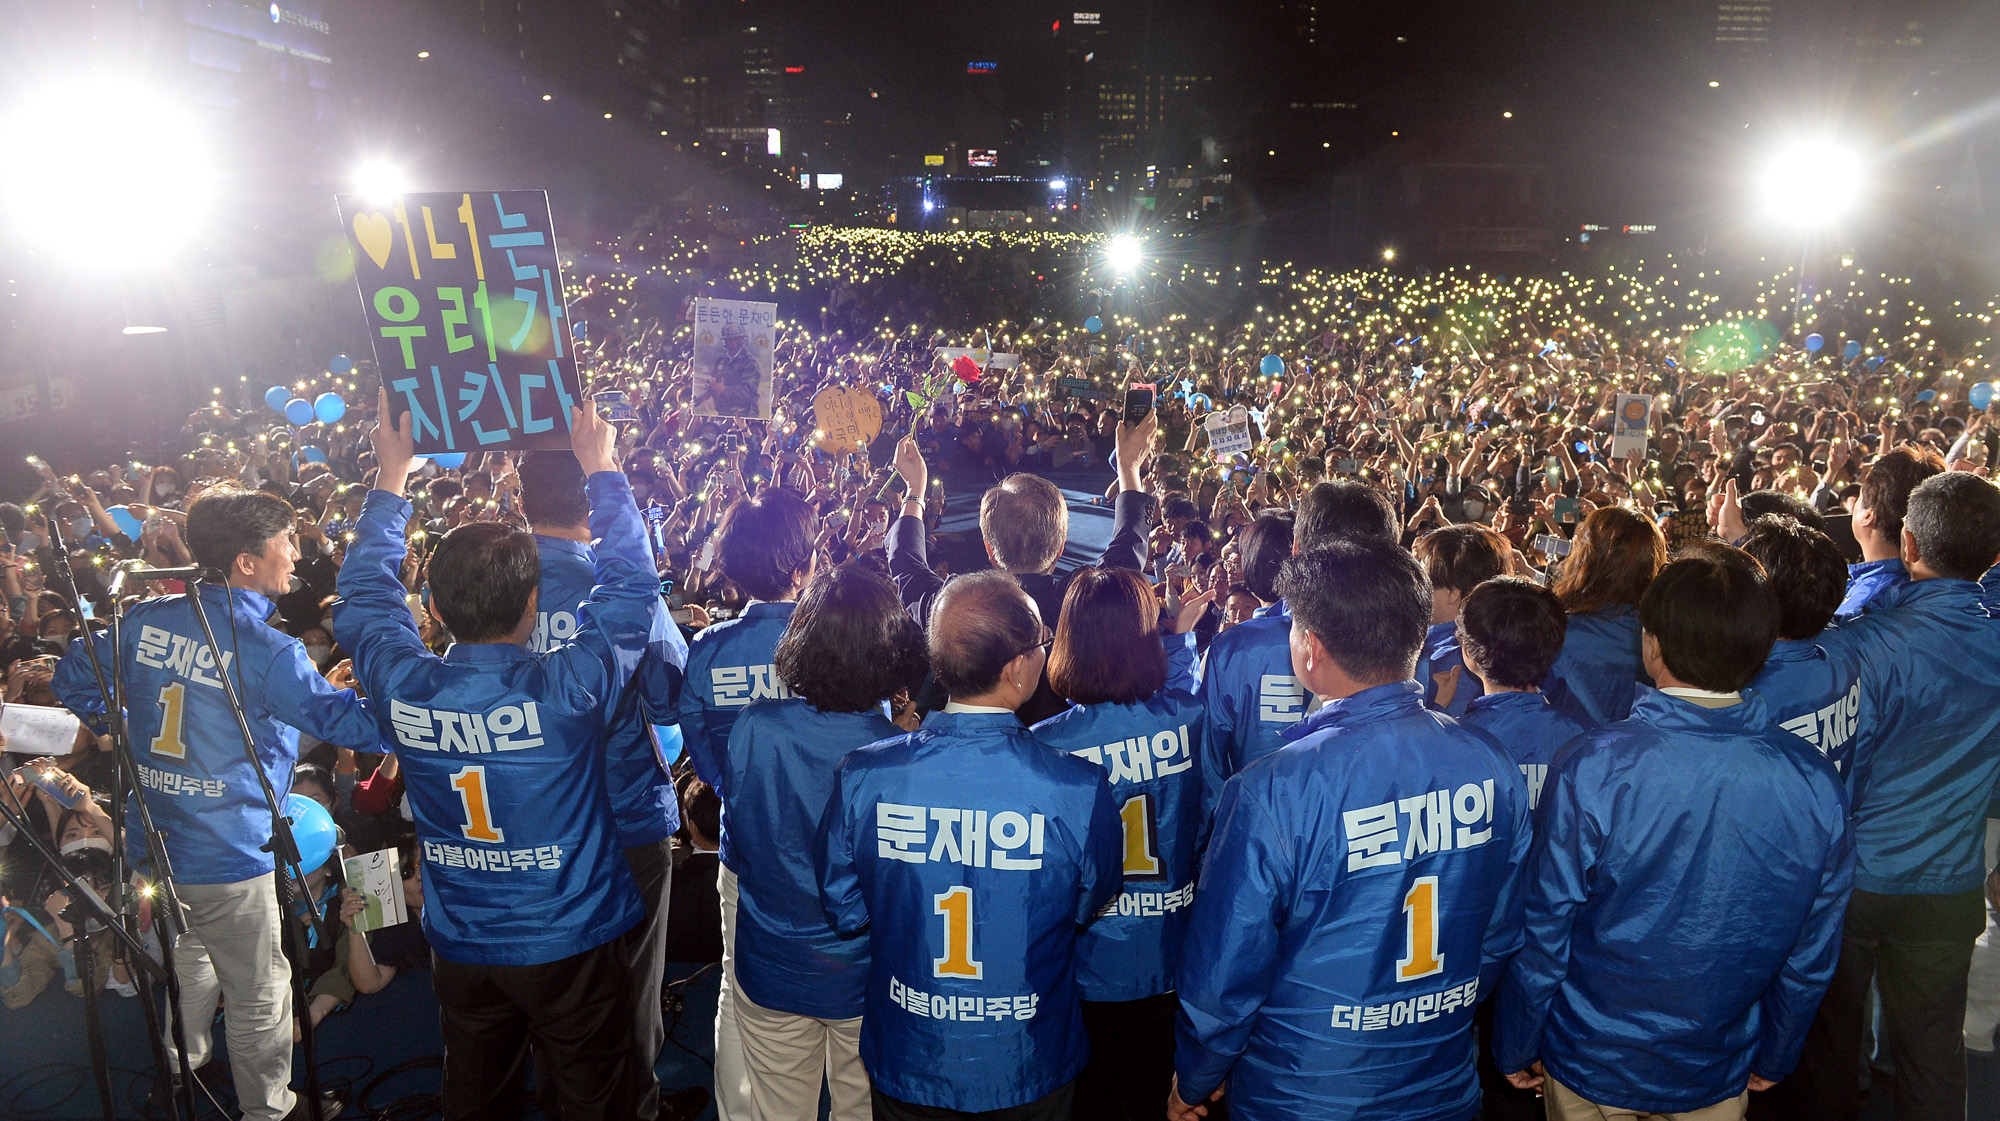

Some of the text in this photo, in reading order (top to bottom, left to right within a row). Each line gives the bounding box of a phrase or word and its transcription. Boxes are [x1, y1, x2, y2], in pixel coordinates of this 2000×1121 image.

[373, 269, 563, 369] 우리가
[697, 305, 774, 328] 든든한 문재인
[392, 359, 574, 450] 지킨다
[136, 625, 233, 689] 문재인
[526, 611, 577, 653] 재인
[711, 663, 797, 706] 문재
[150, 681, 185, 760] 1
[391, 698, 544, 753] 문재인
[137, 764, 228, 798] 불어민주당
[450, 765, 505, 843] 1
[423, 840, 563, 872] 더불어민주당
[876, 802, 1045, 870] 문재인
[1119, 794, 1159, 875] 1
[1342, 778, 1495, 872] 문재인
[1096, 880, 1194, 917] 어민주당
[1396, 875, 1445, 983] 1
[933, 885, 983, 980] 1
[889, 975, 1040, 1022] 더불어민주당
[1331, 976, 1480, 1031] 더불어민주당
